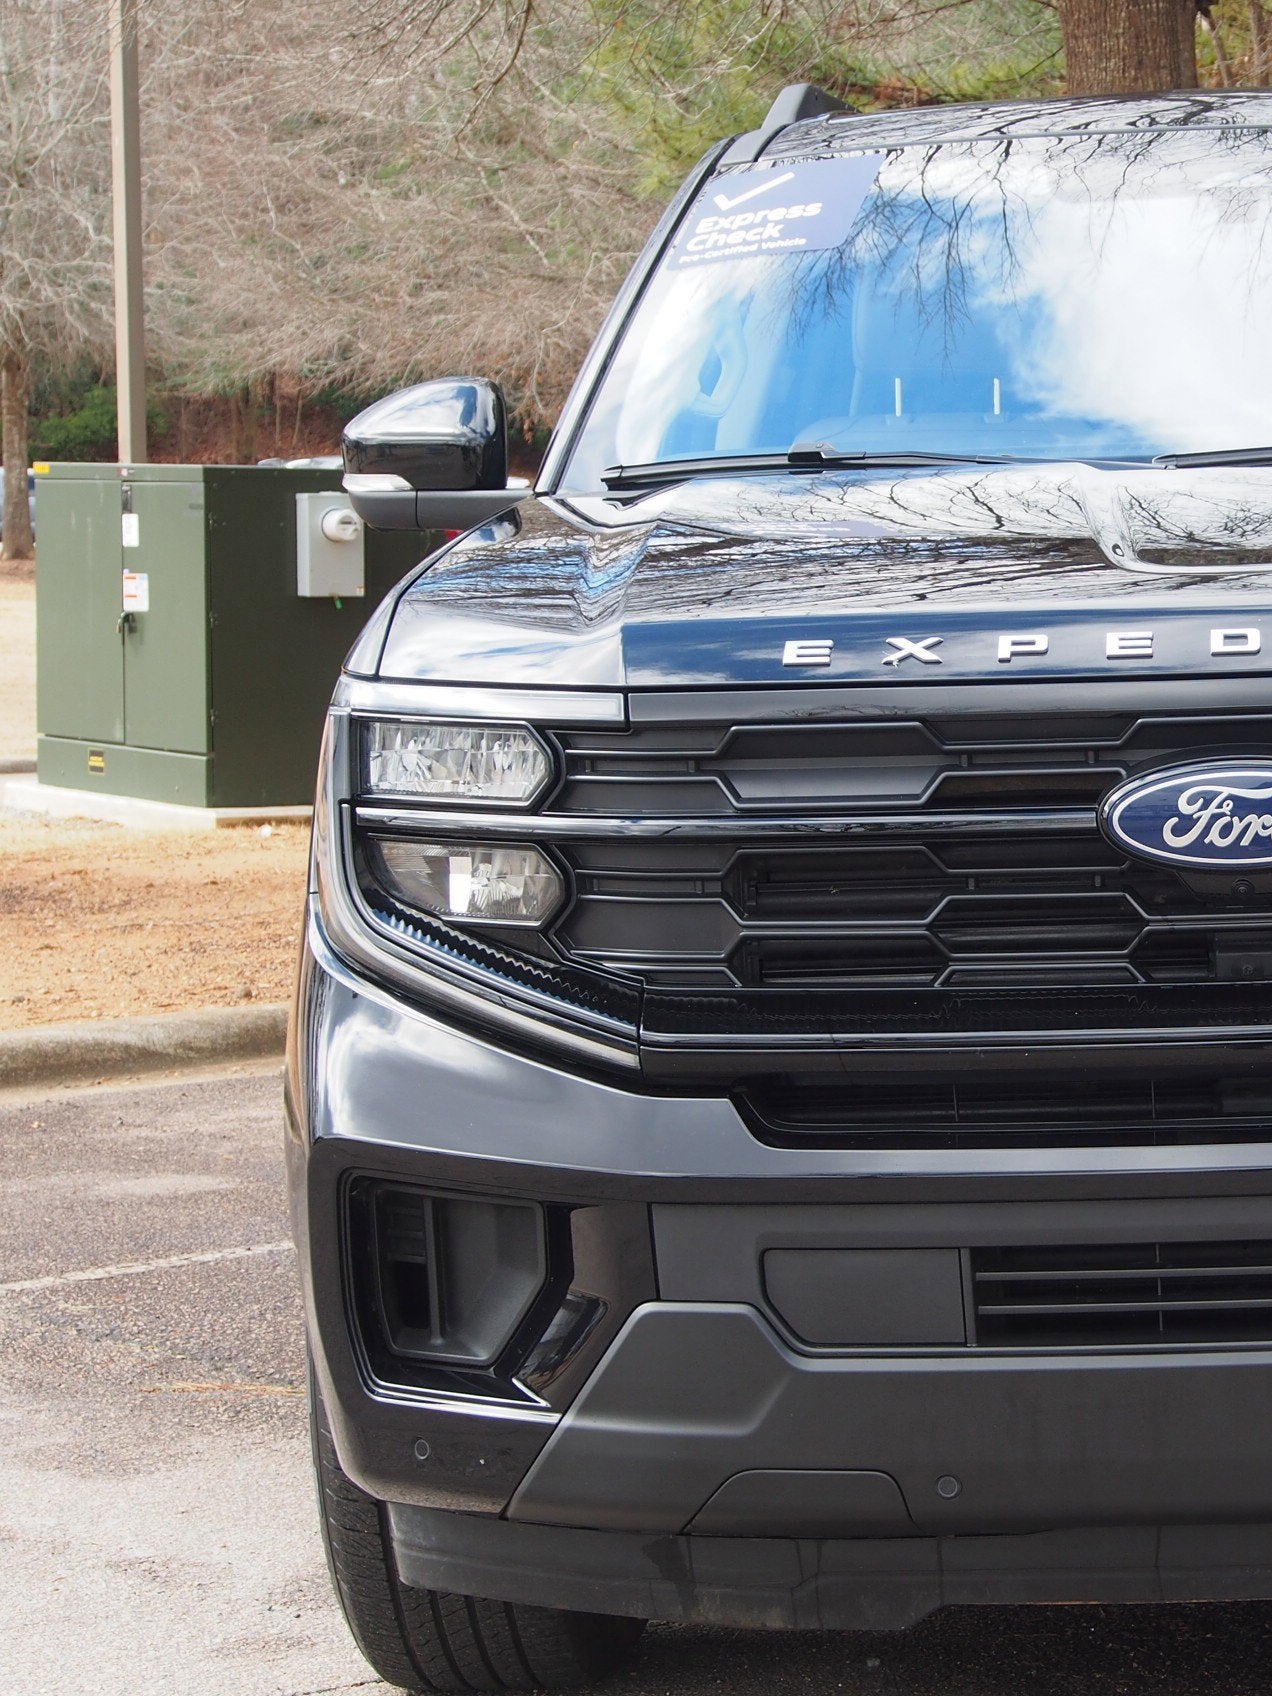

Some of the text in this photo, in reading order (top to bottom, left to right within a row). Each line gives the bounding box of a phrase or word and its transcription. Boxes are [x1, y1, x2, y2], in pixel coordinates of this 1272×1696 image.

[695, 203, 822, 233] Express
[687, 223, 783, 251] Check
[762, 238, 806, 249] Vehicle
